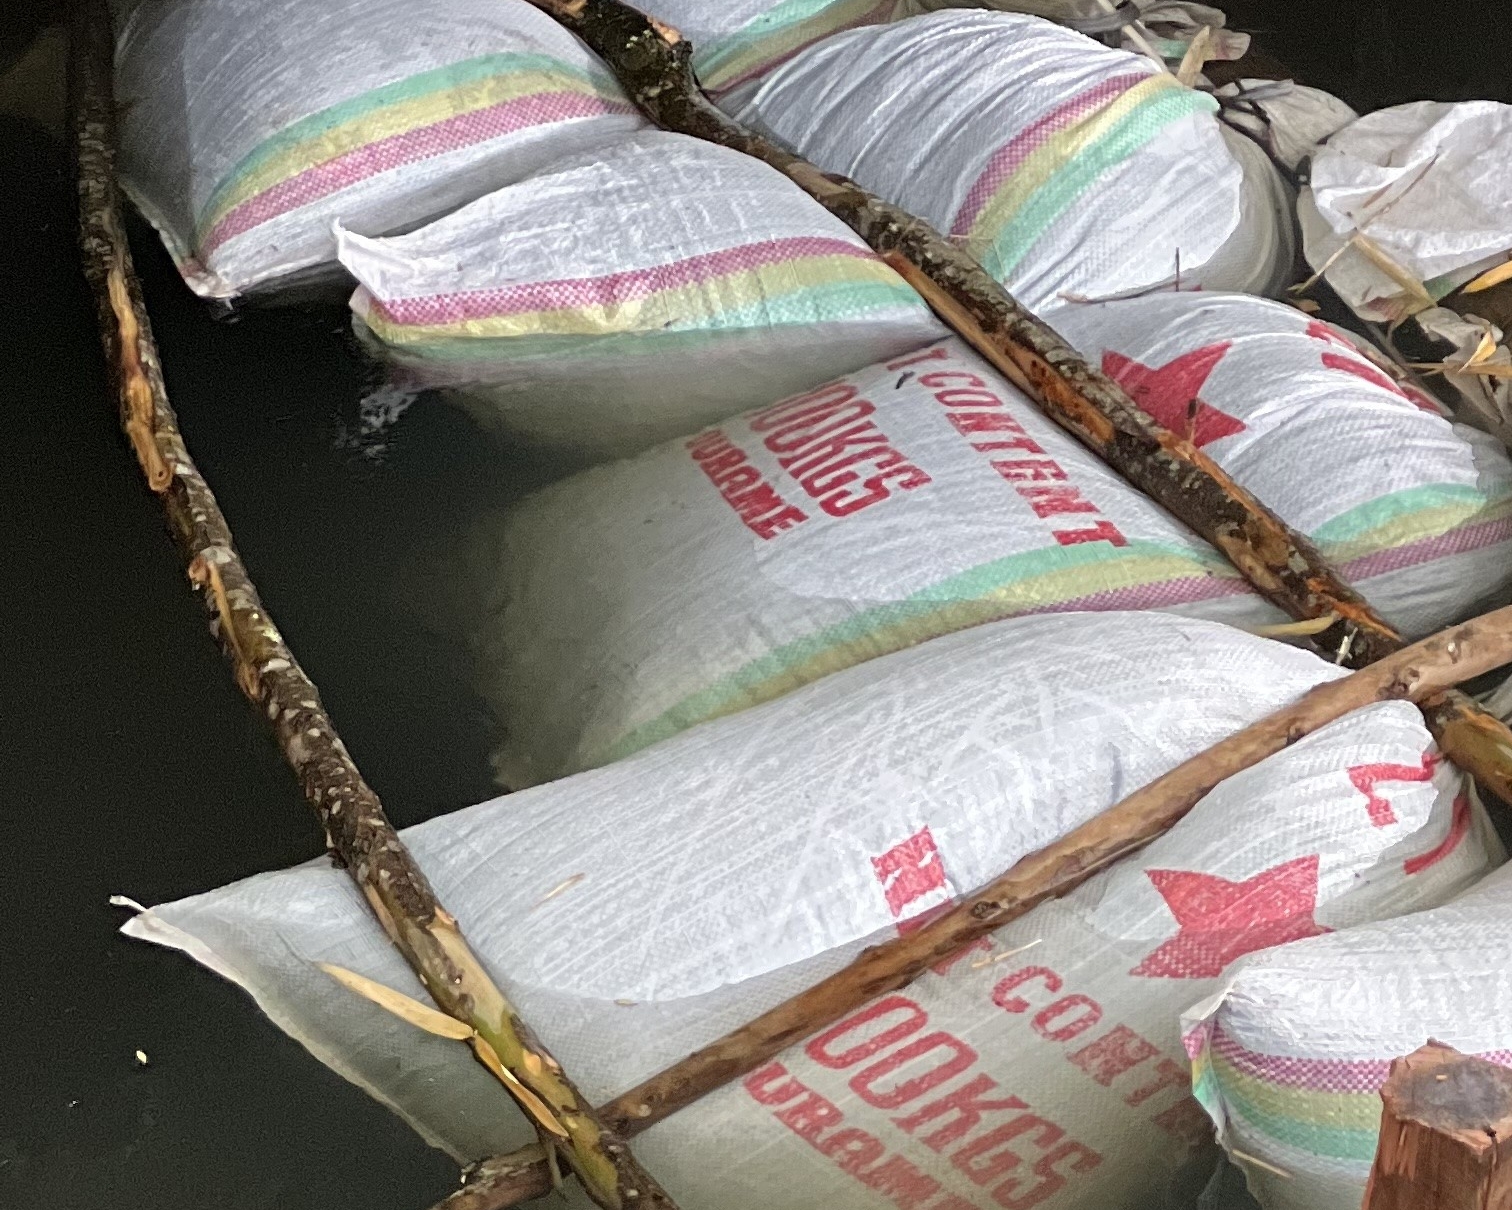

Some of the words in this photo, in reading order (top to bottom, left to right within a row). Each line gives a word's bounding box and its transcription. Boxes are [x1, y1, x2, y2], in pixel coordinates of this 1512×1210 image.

[684, 427, 809, 541] URAME
[744, 377, 932, 517] 00KGS
[918, 370, 1132, 547] CONTENT
